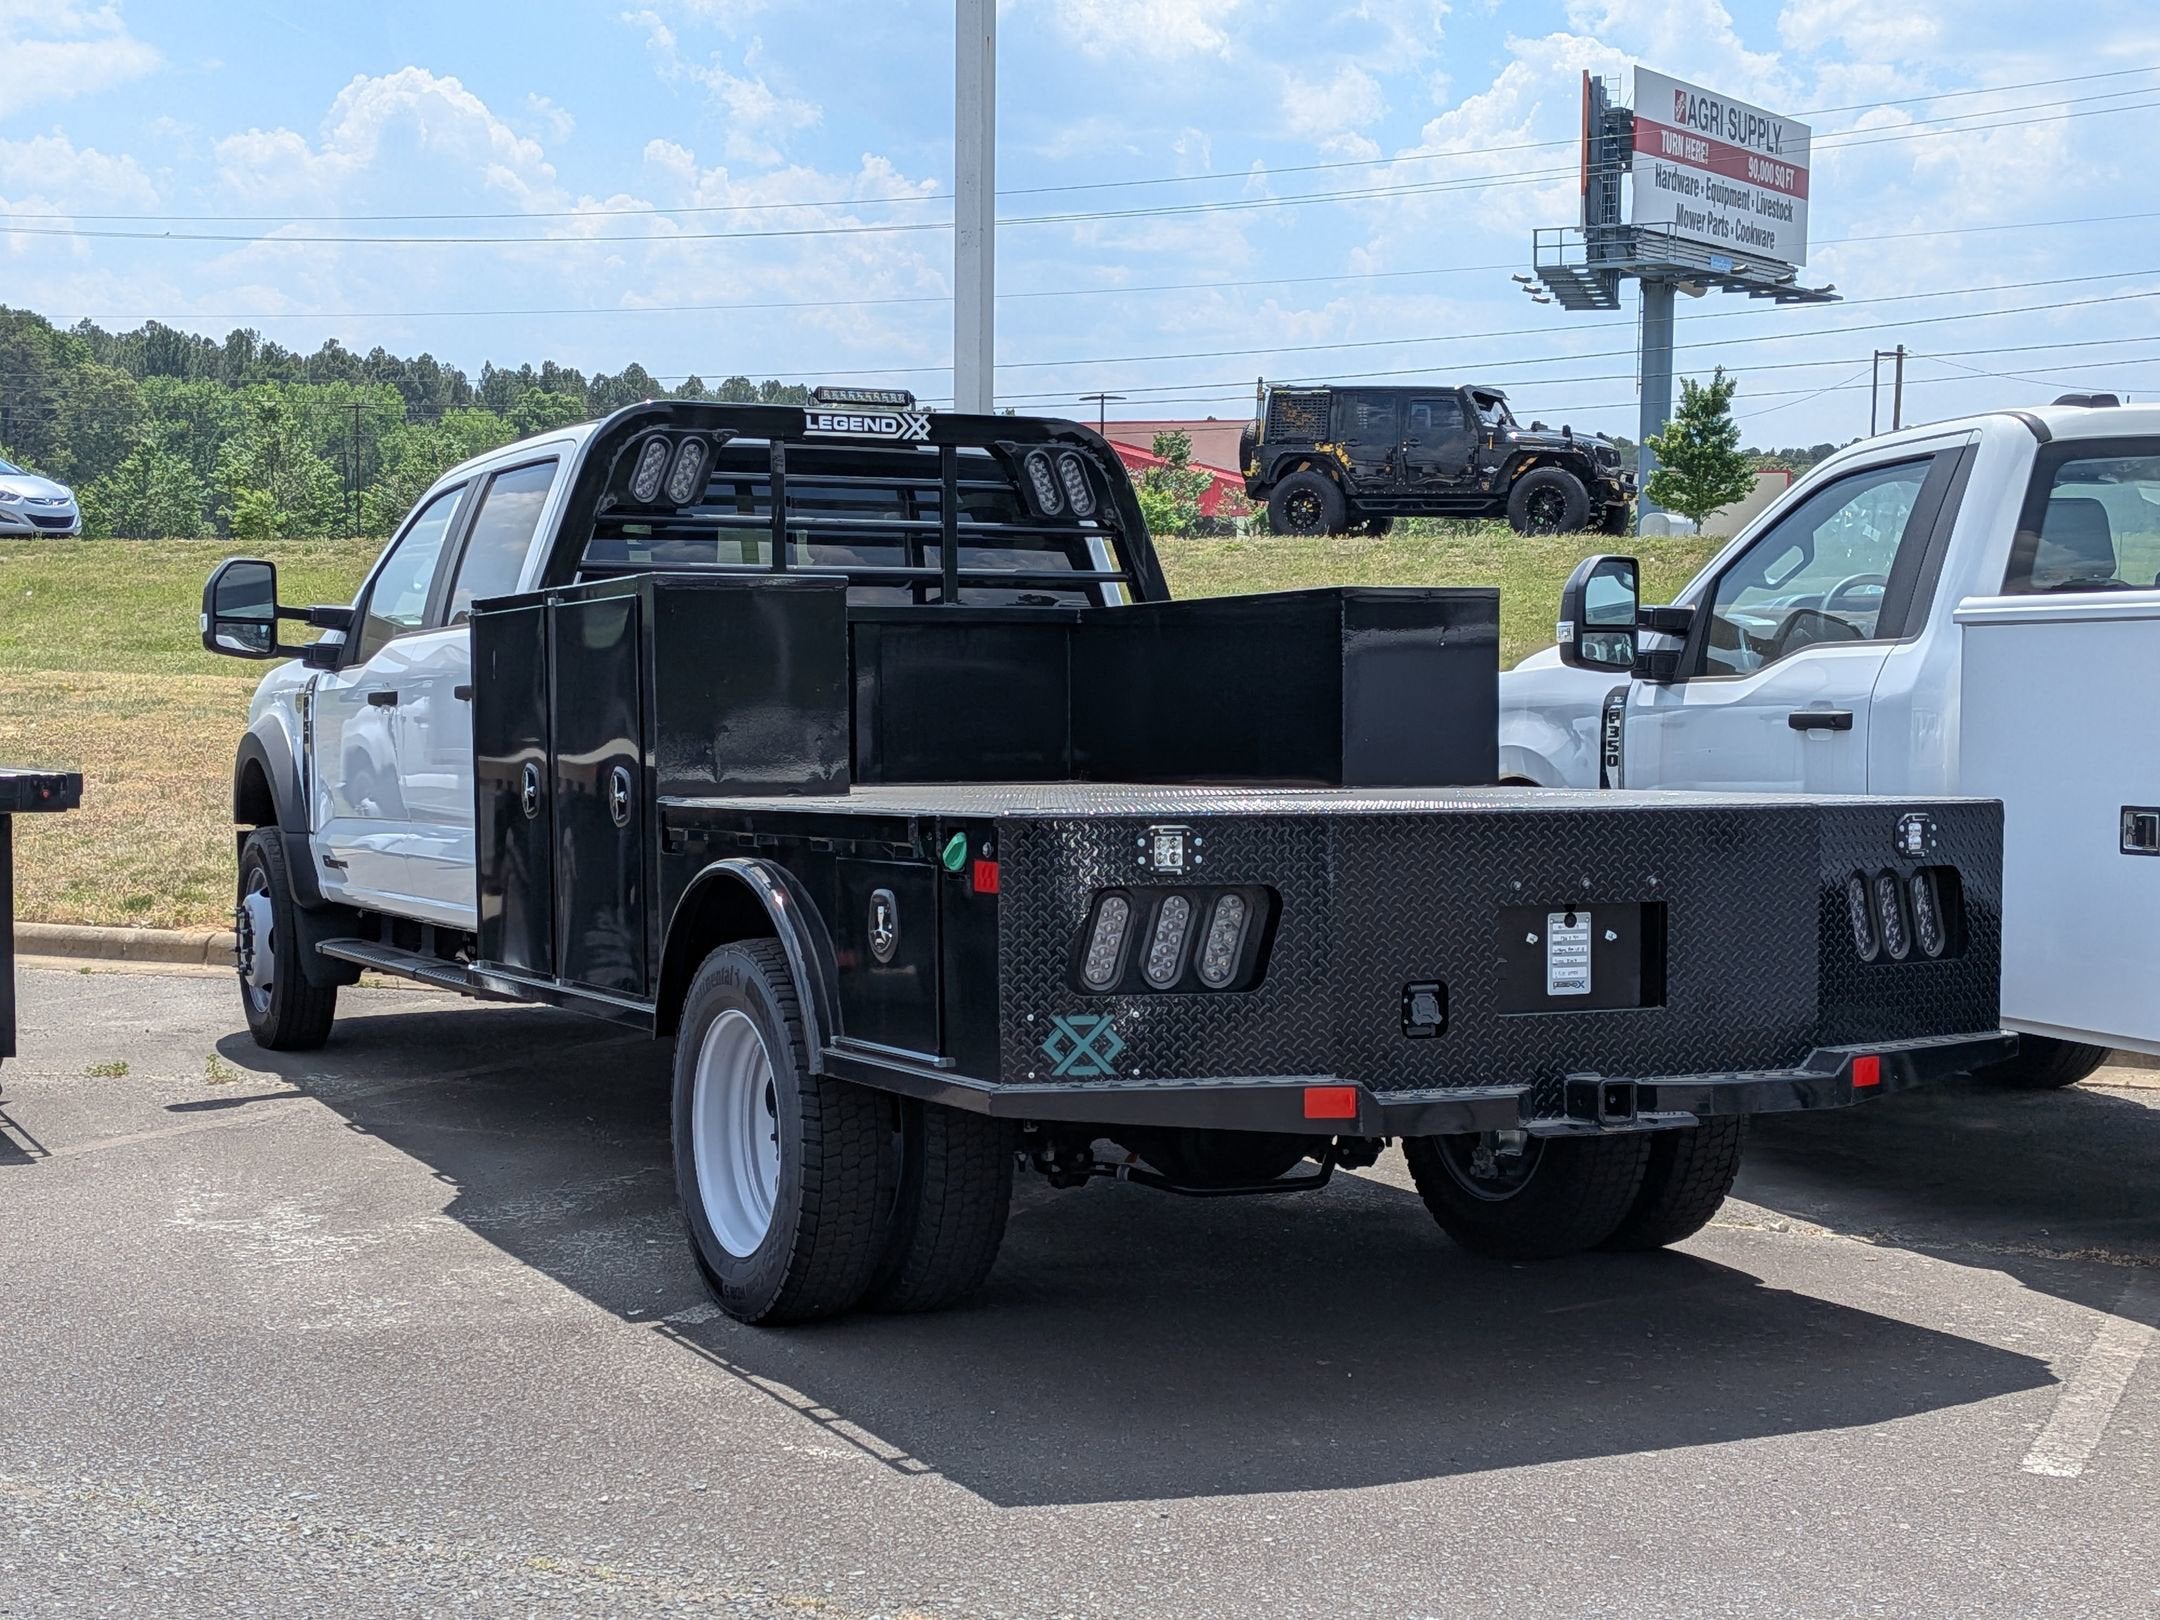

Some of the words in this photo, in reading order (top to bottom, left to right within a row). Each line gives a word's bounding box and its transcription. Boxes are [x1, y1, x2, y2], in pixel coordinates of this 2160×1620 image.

[1661, 130, 1683, 157] TURN
[1685, 137, 1709, 164] HERE!
[1687, 94, 1723, 136] AGRI
[1728, 107, 1782, 154] SUPPLY
[1655, 163, 1699, 197] Hardware
[1706, 176, 1750, 211] Equipment
[1756, 191, 1793, 222] Livestock
[1748, 156, 1774, 185] 90,000
[1774, 165, 1785, 189] SQ
[1786, 168, 1795, 190] FT
[1676, 203, 1706, 234] Mower
[1707, 210, 1730, 238] Parts
[1736, 218, 1776, 250] Cookware
